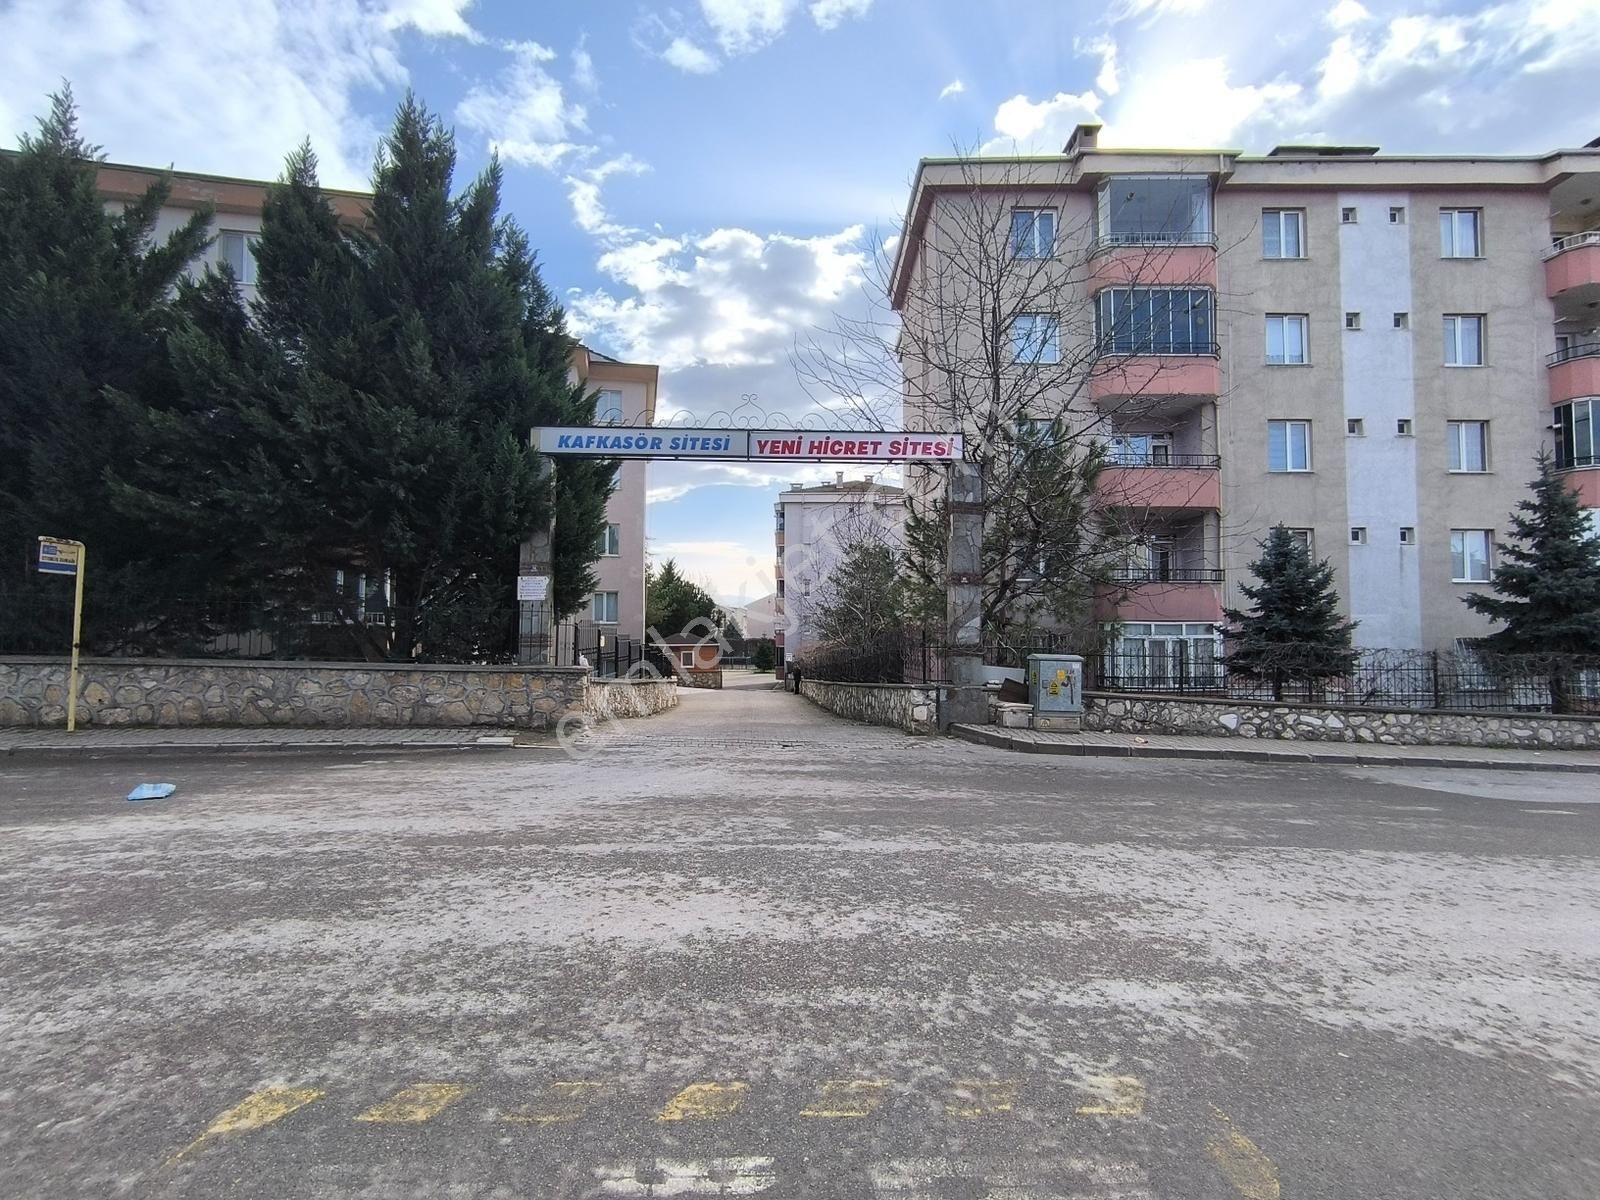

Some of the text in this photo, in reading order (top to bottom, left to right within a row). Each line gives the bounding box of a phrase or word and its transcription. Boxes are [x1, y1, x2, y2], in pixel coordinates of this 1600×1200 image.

[558, 433, 730, 451] KAFKASÖR SİTESİ
[756, 435, 954, 456] YENİ HİCRET SİTESİ
